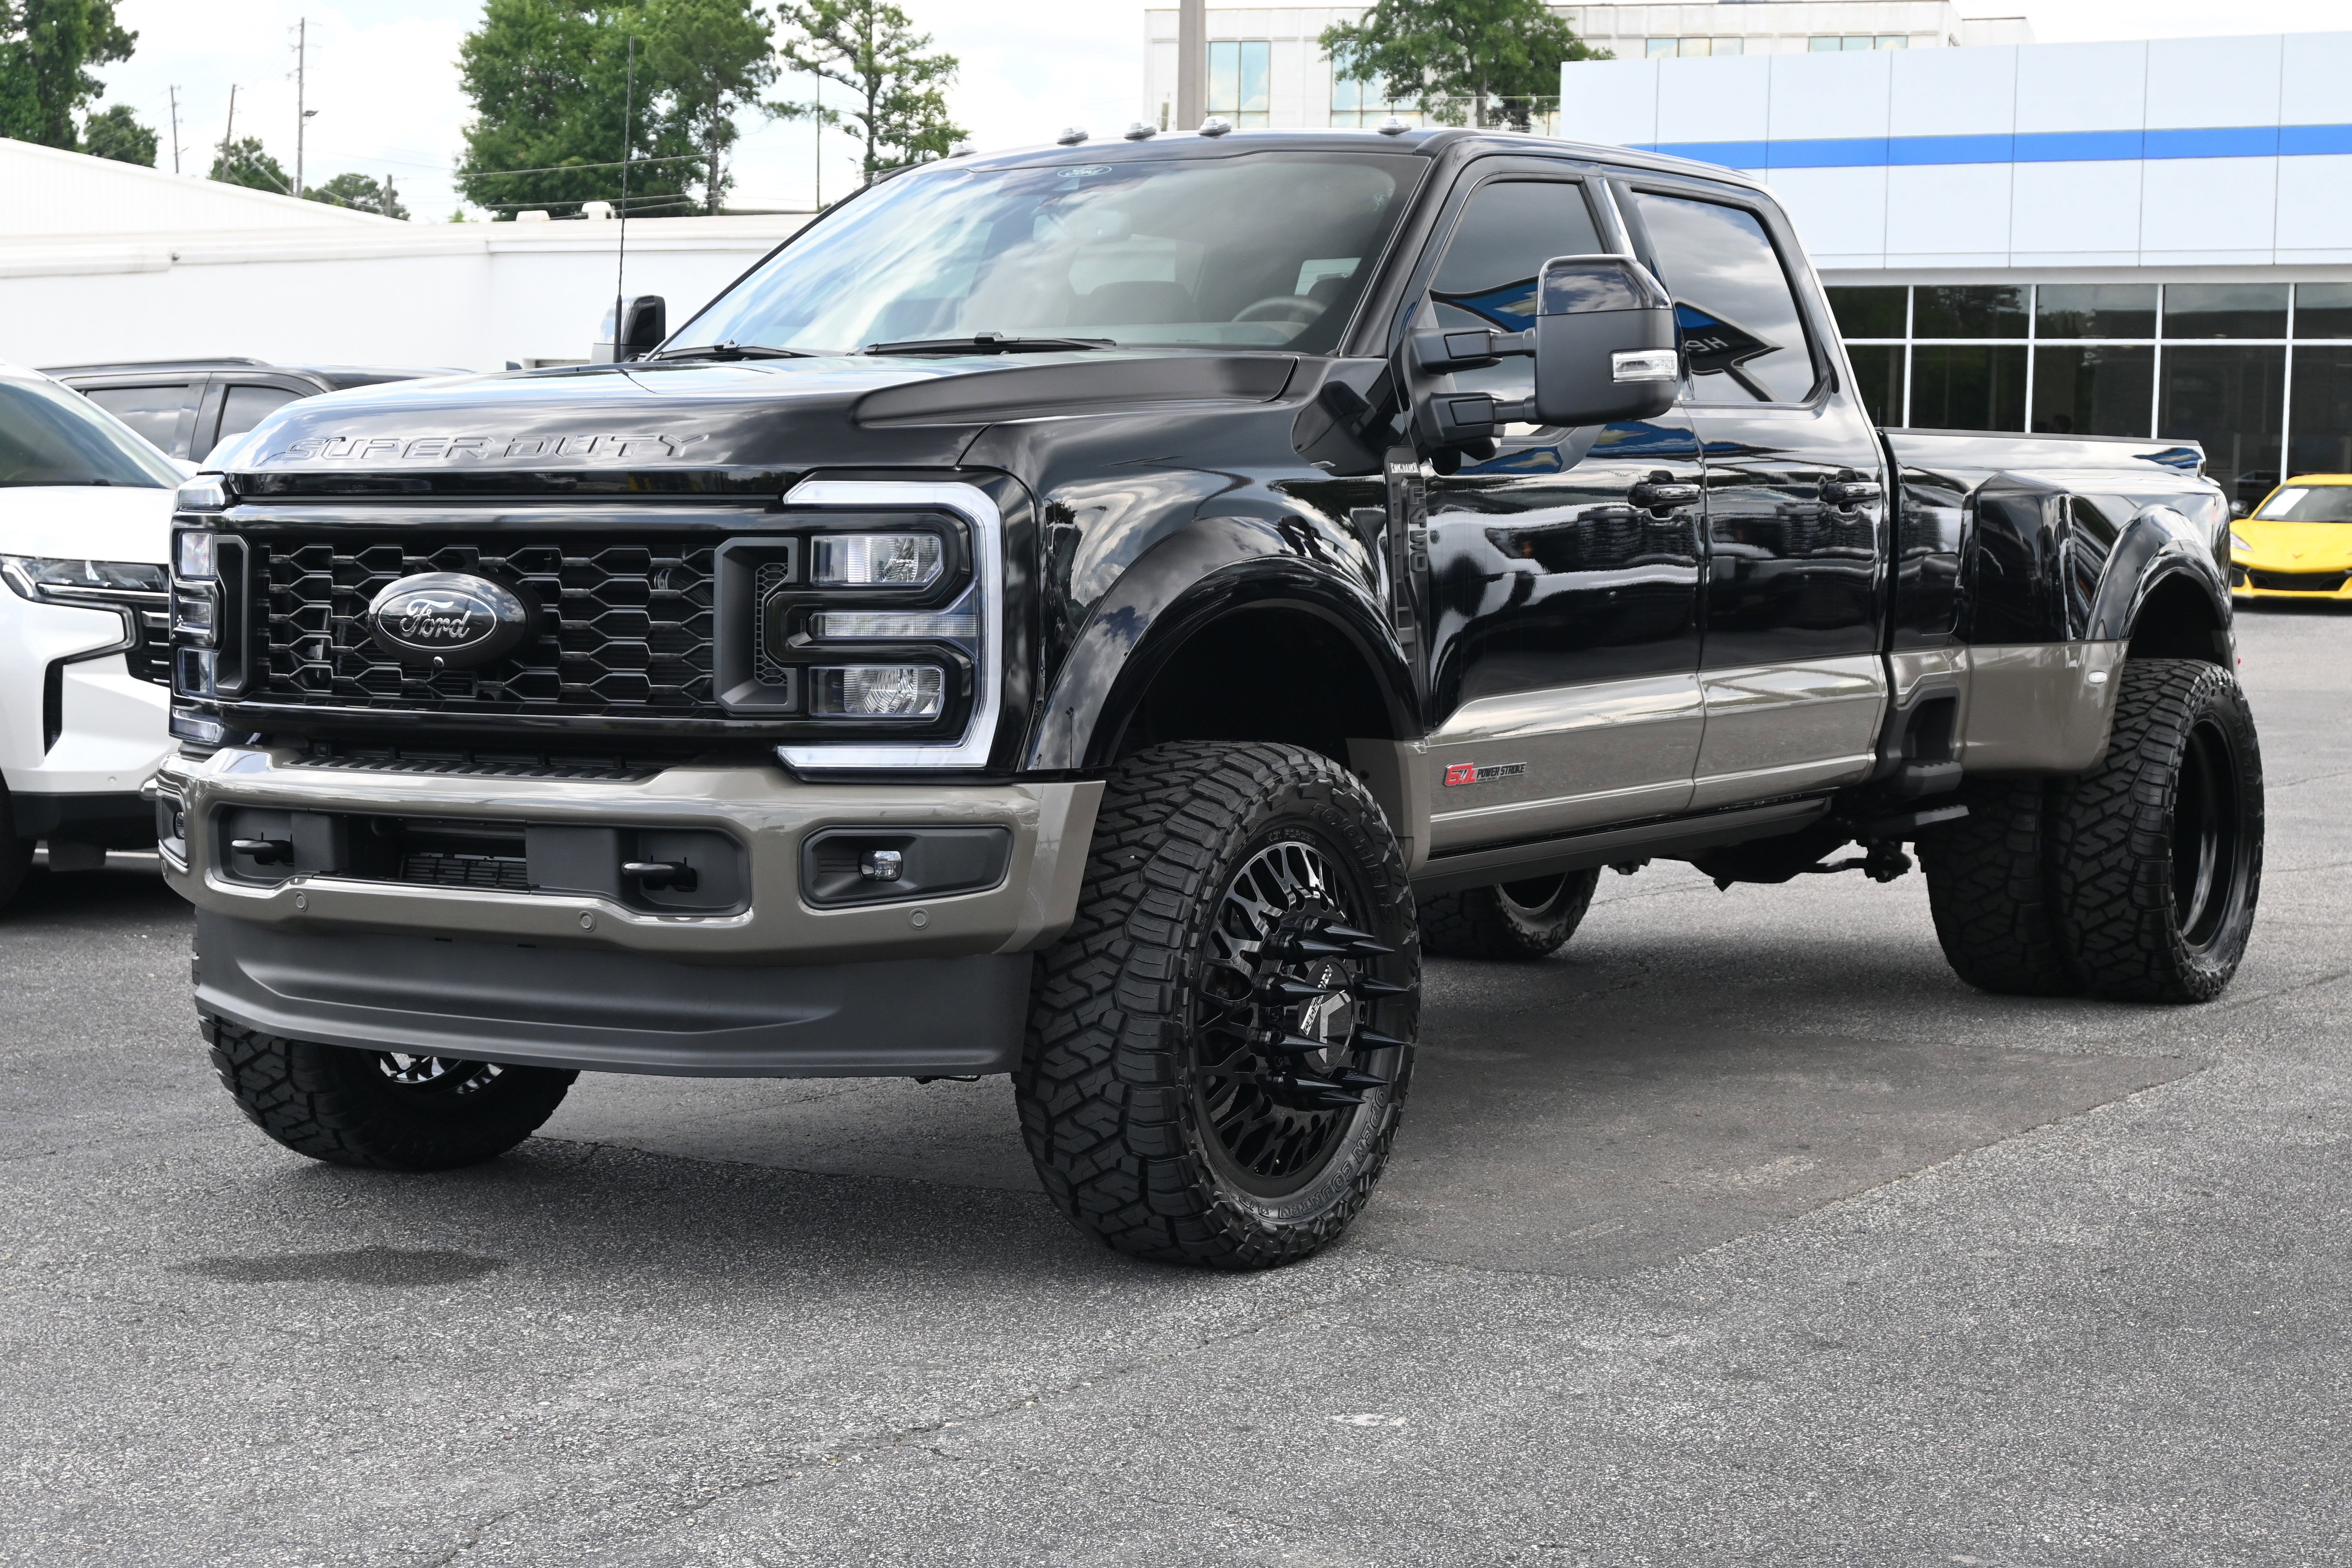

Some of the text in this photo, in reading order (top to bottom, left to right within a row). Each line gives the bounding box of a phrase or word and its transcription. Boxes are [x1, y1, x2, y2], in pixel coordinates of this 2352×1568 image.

[1065, 166, 1104, 176] Ford
[281, 433, 710, 460] SUPER DUTY
[399, 598, 472, 638] Ford
[1446, 763, 1526, 786] 6.7L POWER STROKE
[1309, 803, 1399, 923] TOYO TIRES
[1302, 994, 1323, 1034] ORGED
[1352, 1084, 1389, 1162] OPEN
[1278, 1160, 1355, 1219] COUNTRY
